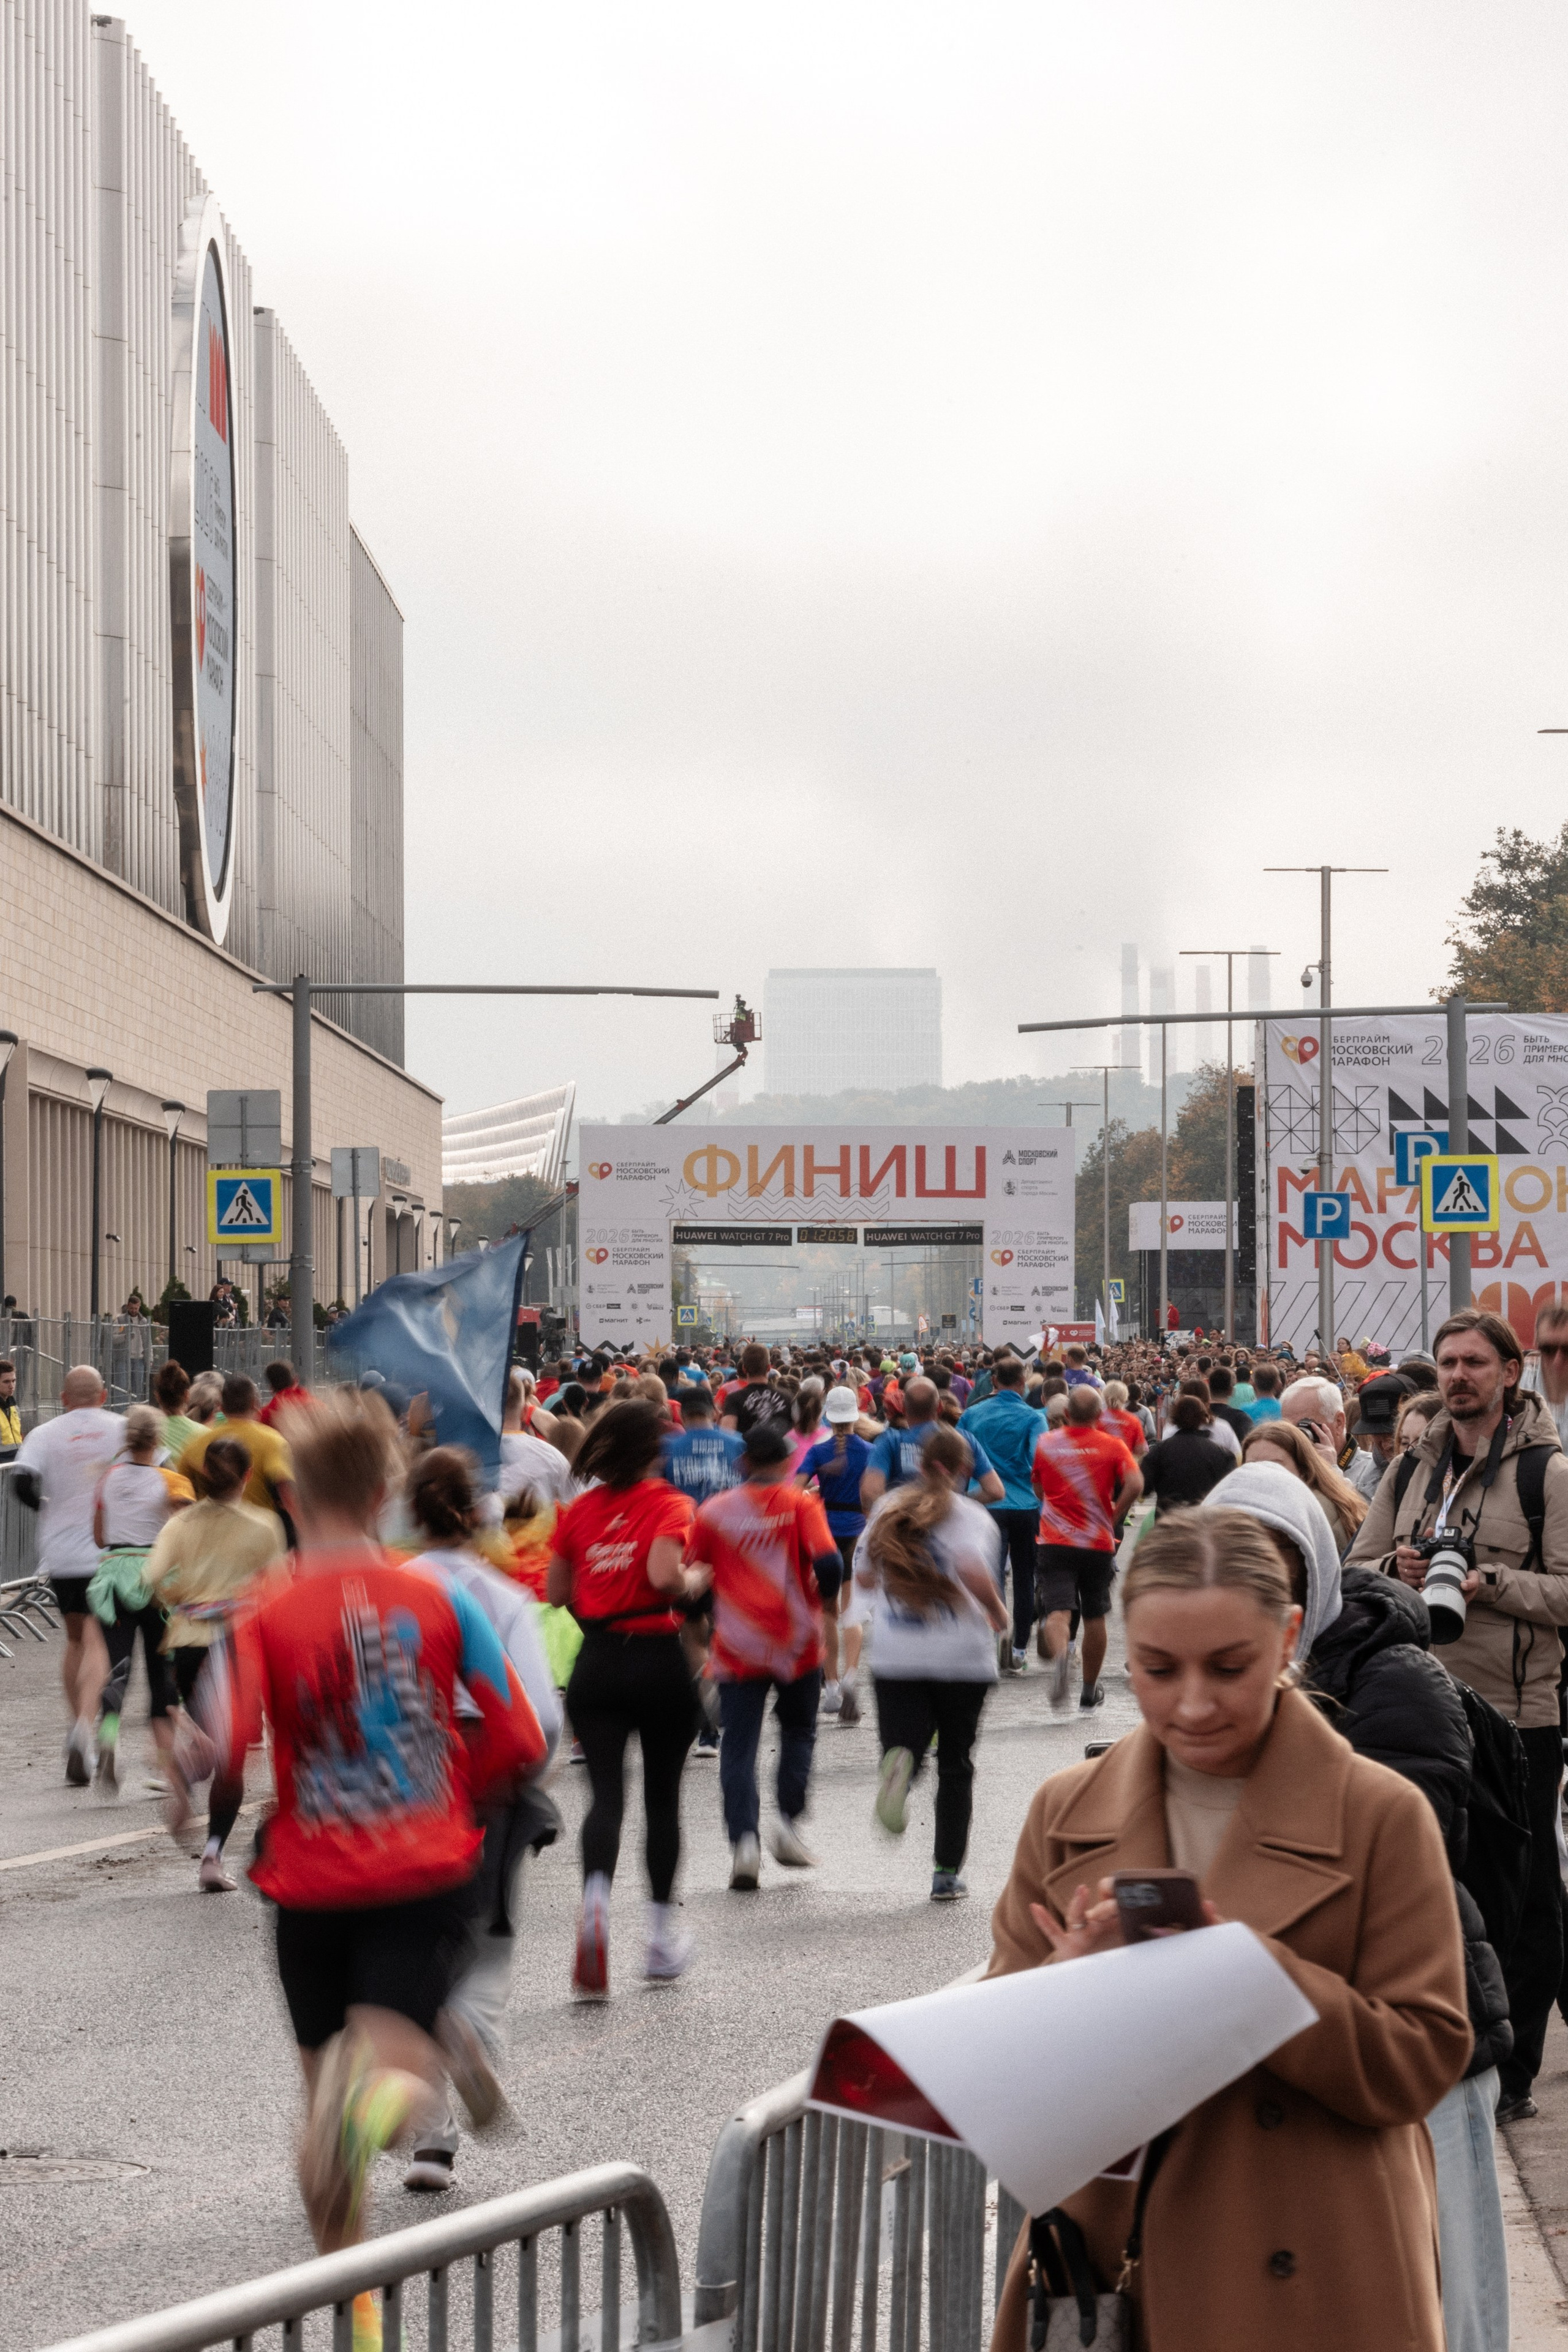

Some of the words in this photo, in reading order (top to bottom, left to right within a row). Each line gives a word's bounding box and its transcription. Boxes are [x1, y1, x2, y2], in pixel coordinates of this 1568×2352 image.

[1333, 1034, 1390, 1043] БЕРПРАЙМ
[1422, 1035, 1515, 1065] 226
[1523, 1055, 1544, 1064] ДЛЯ
[1019, 1149, 1058, 1158] МОСКОВСКИЙ
[1408, 1135, 1440, 1183] P
[683, 1144, 986, 1198] ФИНИШ
[1317, 1197, 1342, 1234] P
[586, 1228, 630, 1243] 2026
[676, 1231, 717, 1240] HUAWEI
[754, 1232, 766, 1241] GT
[768, 1232, 774, 1241] 7
[775, 1232, 790, 1241] Pro
[866, 1232, 907, 1241] HUAWEI
[911, 1232, 943, 1240] WATCH
[944, 1232, 956, 1240] GT
[959, 1232, 964, 1240] 7
[966, 1231, 980, 1240] Pro
[990, 1231, 1035, 1245] 2026
[1338, 1448, 1353, 1467] Nikon
